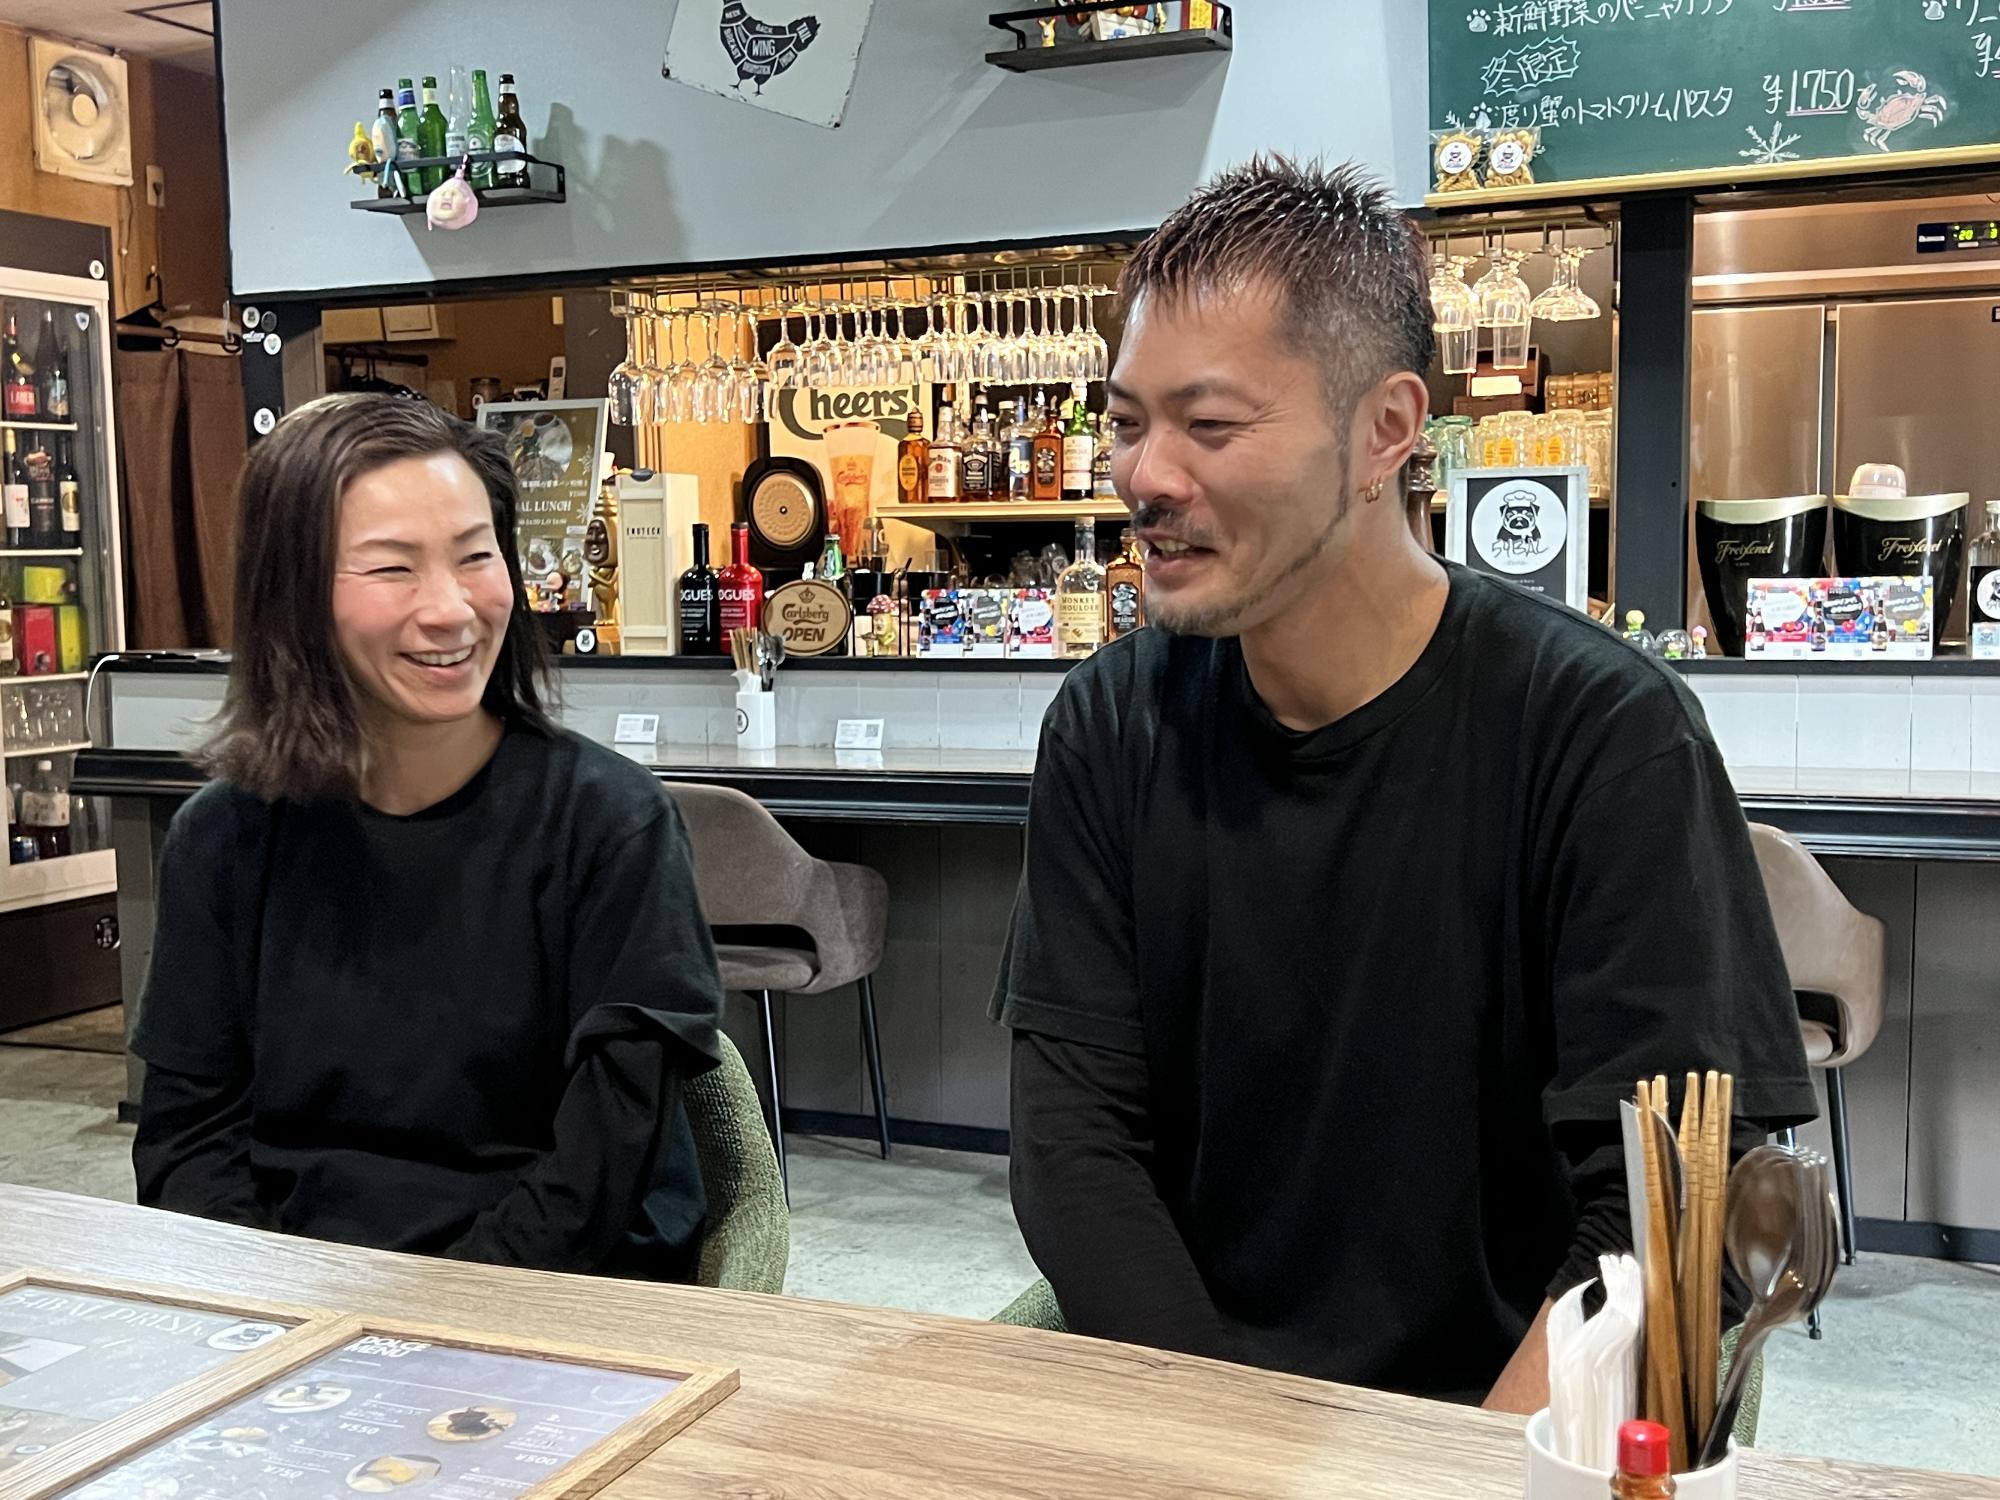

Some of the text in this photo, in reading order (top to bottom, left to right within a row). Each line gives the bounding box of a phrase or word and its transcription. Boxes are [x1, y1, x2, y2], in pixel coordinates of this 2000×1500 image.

[723, 28, 742, 60] BREAST
[752, 39, 776, 57] WING
[534, 500, 572, 512] LUNCH
[1714, 540, 1775, 564] Freixenet
[1877, 537, 1943, 562] Freixenet
[782, 603, 829, 625] Carlsberg
[783, 627, 826, 642] OPEN
[343, 1343, 413, 1358] MENU
[359, 1336, 432, 1352] DOLCE
